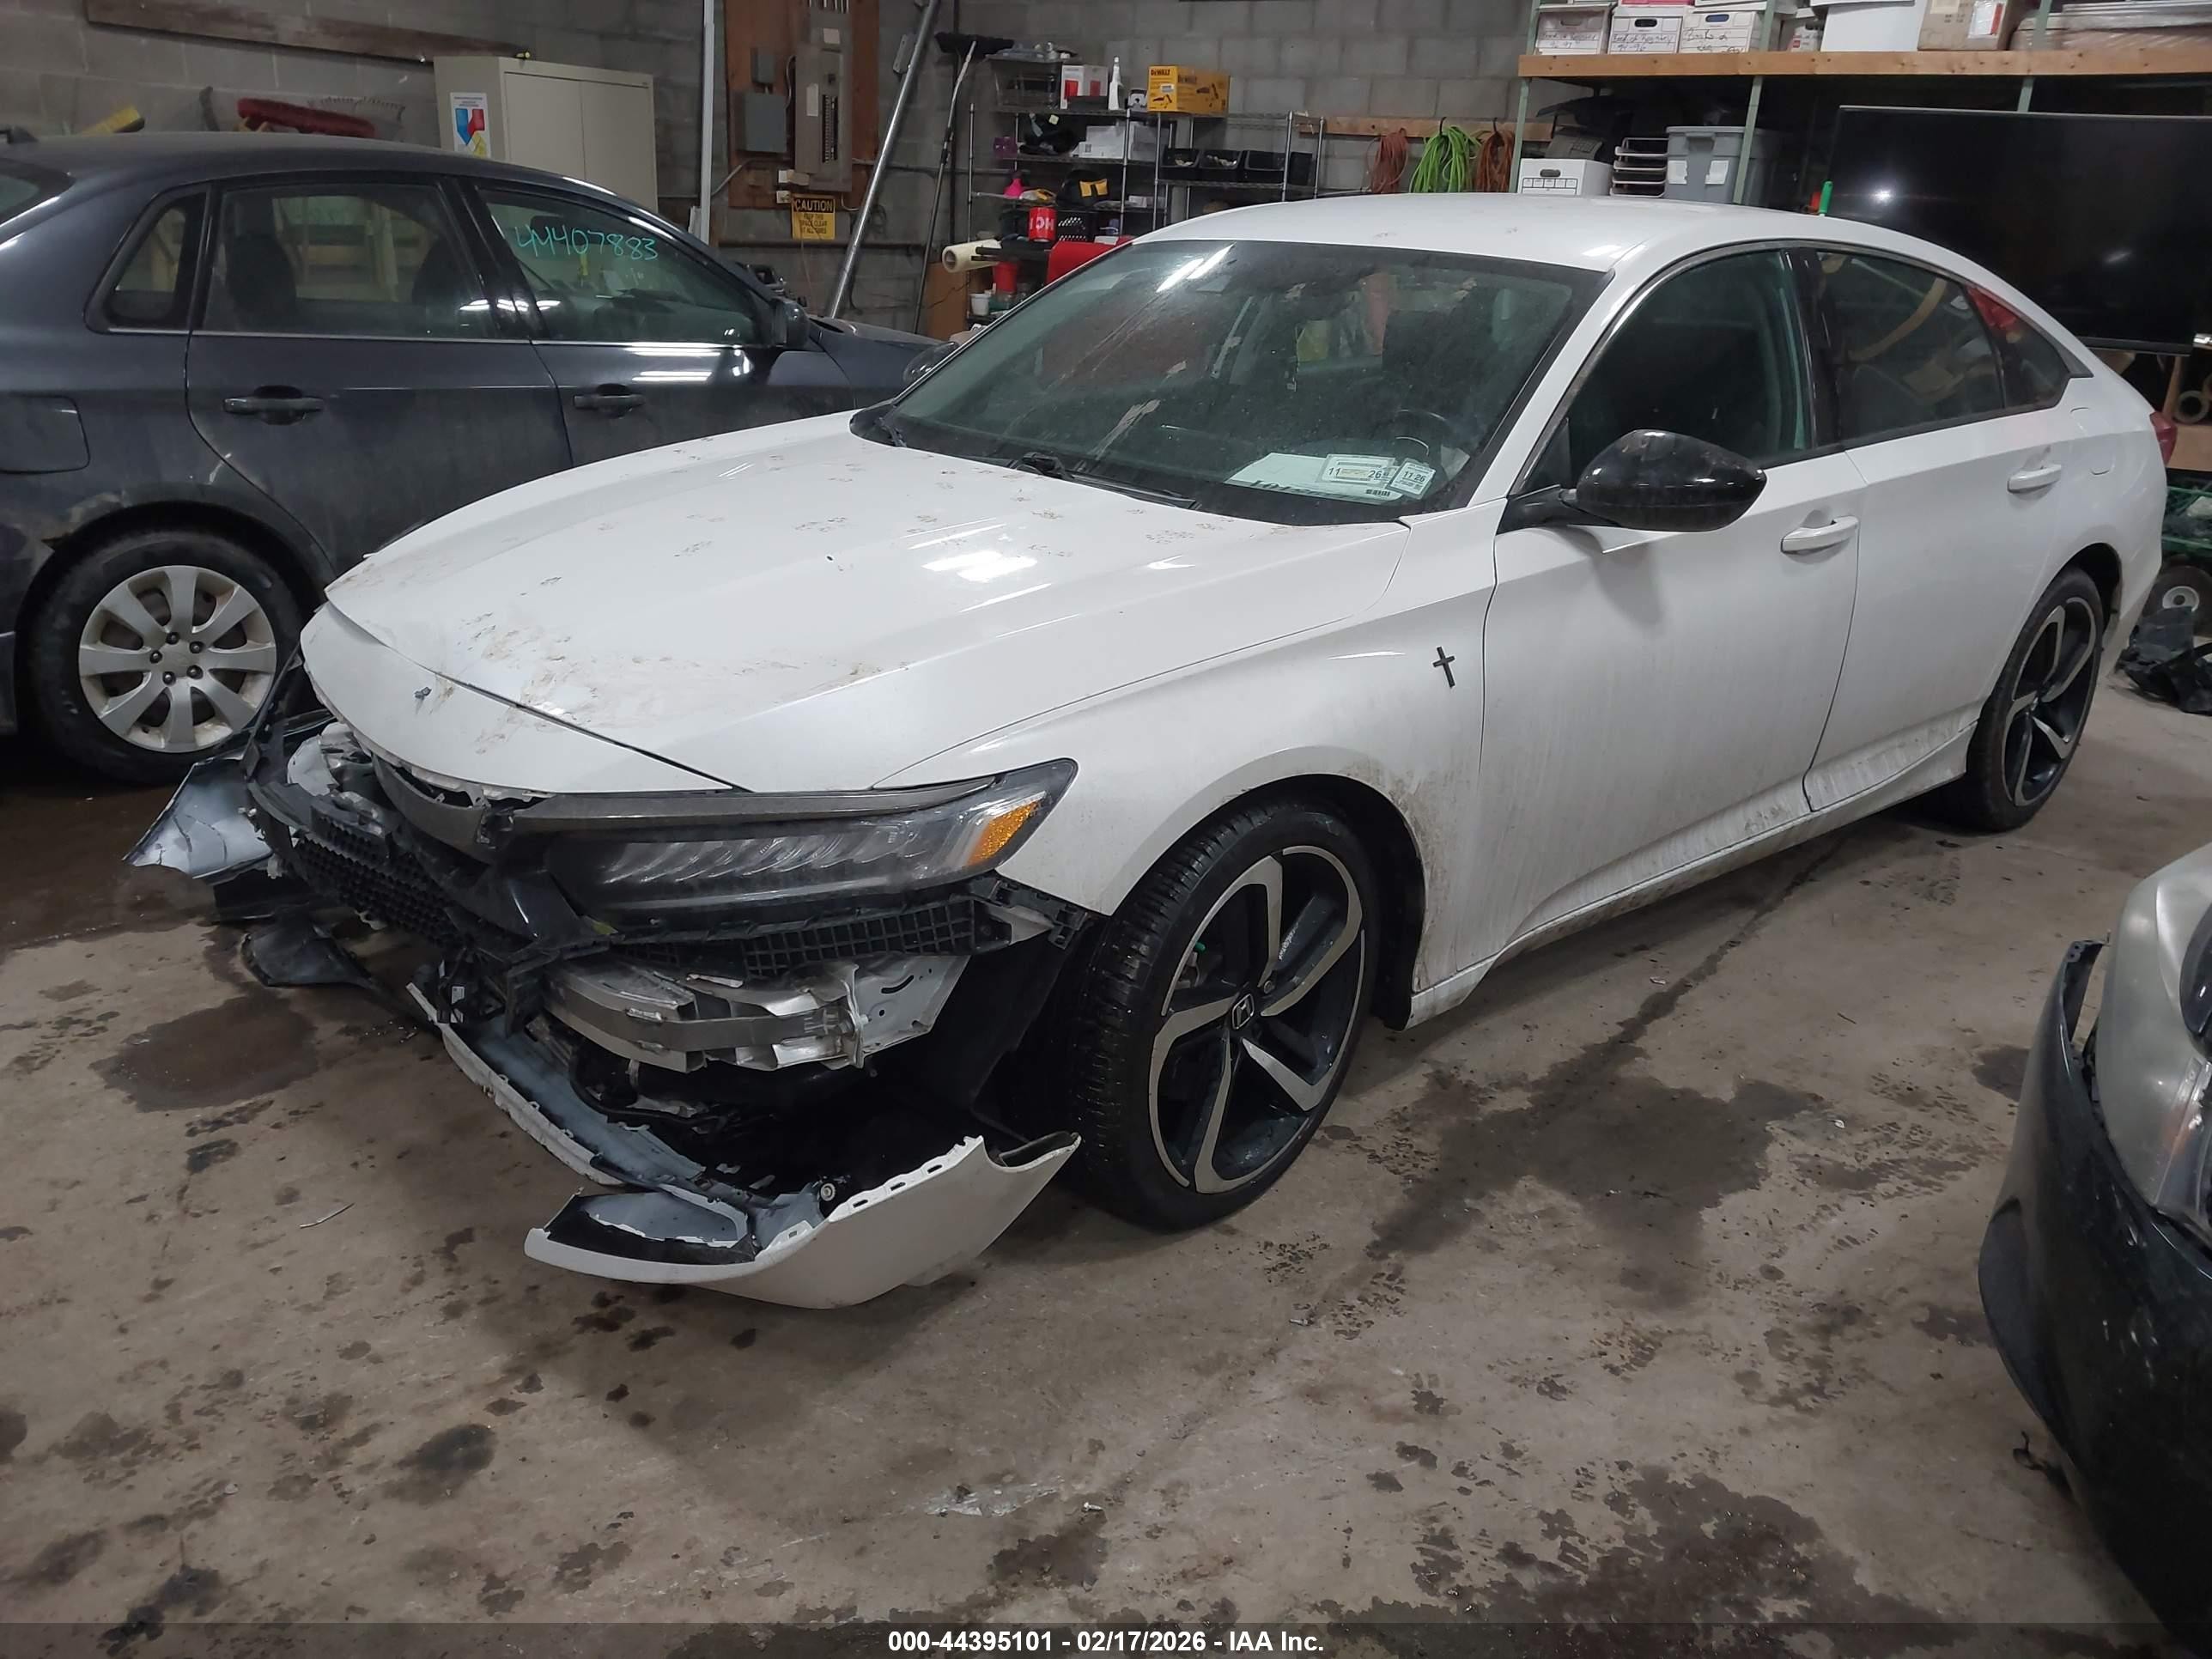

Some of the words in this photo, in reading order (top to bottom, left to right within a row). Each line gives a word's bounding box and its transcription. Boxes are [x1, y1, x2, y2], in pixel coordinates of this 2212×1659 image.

[795, 198, 833, 212] CAUTION
[1328, 468, 1340, 477] 11
[1367, 470, 1382, 479] 26
